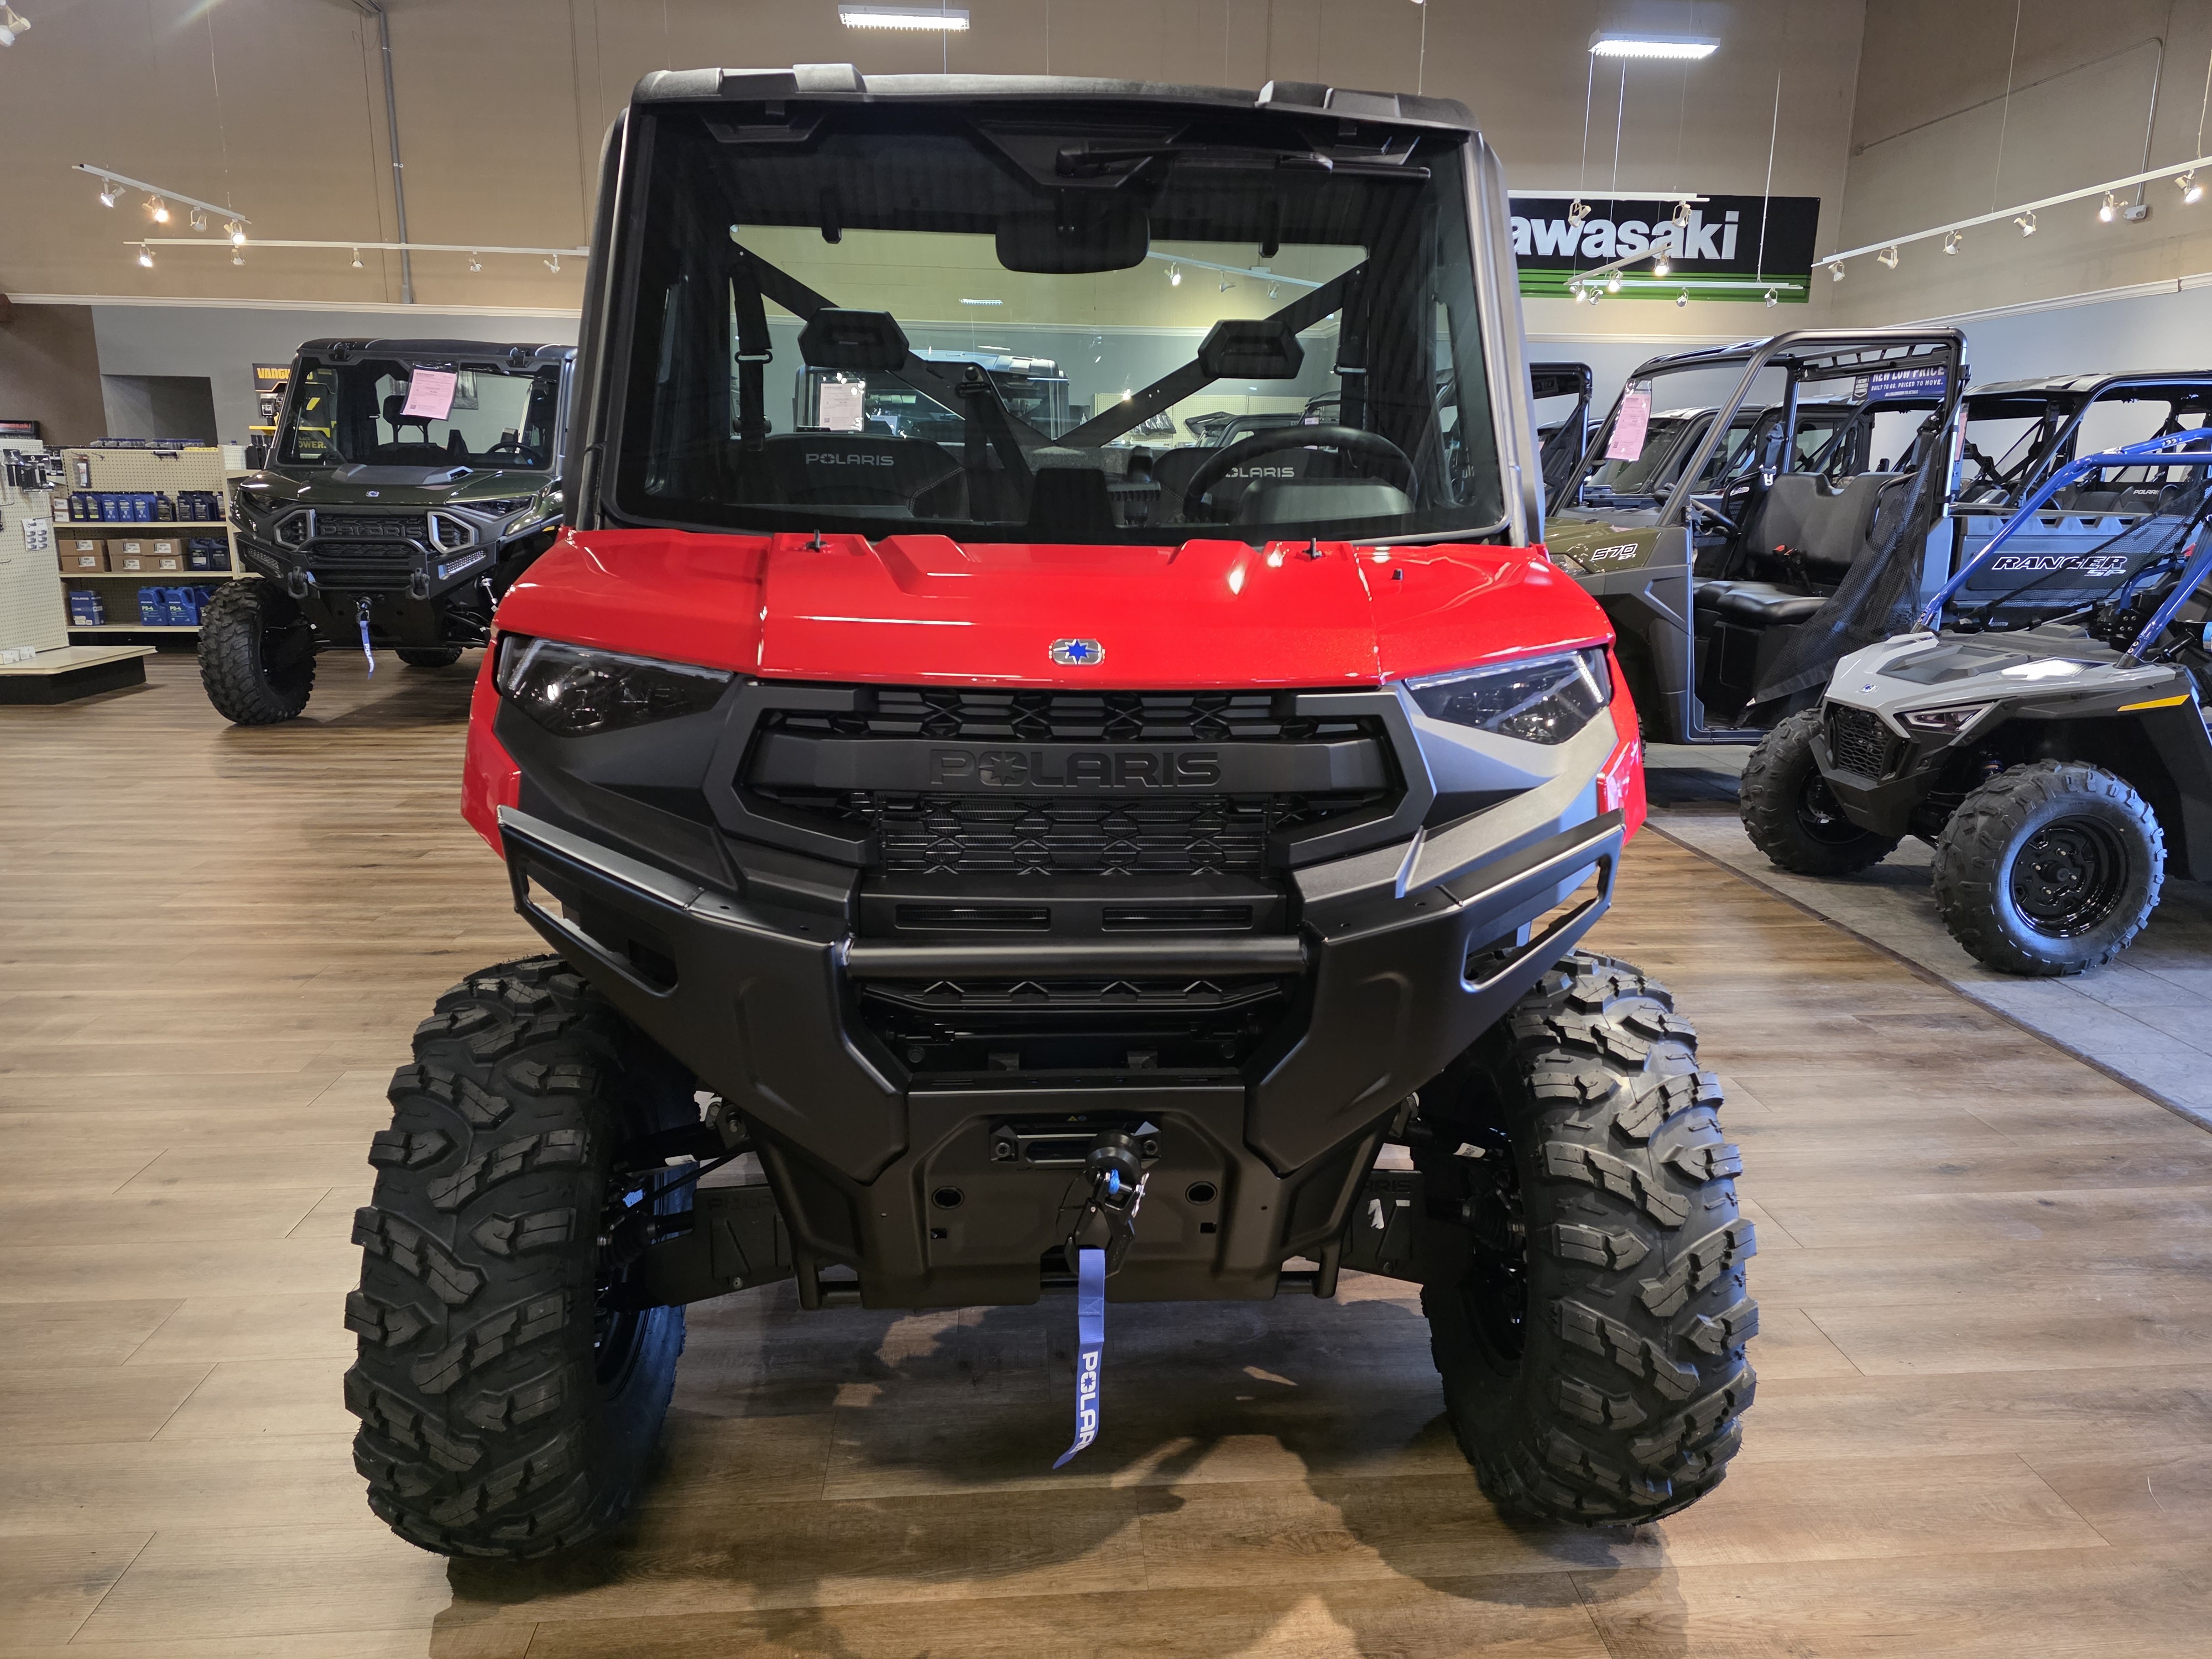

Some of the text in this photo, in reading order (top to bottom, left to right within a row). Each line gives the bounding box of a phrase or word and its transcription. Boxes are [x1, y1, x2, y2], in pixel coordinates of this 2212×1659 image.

[1511, 210, 1740, 260] awasaki
[805, 453, 894, 466] POLARIS
[1225, 467, 1295, 478] OLARIS
[1591, 543, 1638, 560] 570
[1991, 556, 2128, 570] RANGER
[930, 749, 1221, 787] POLARIS
